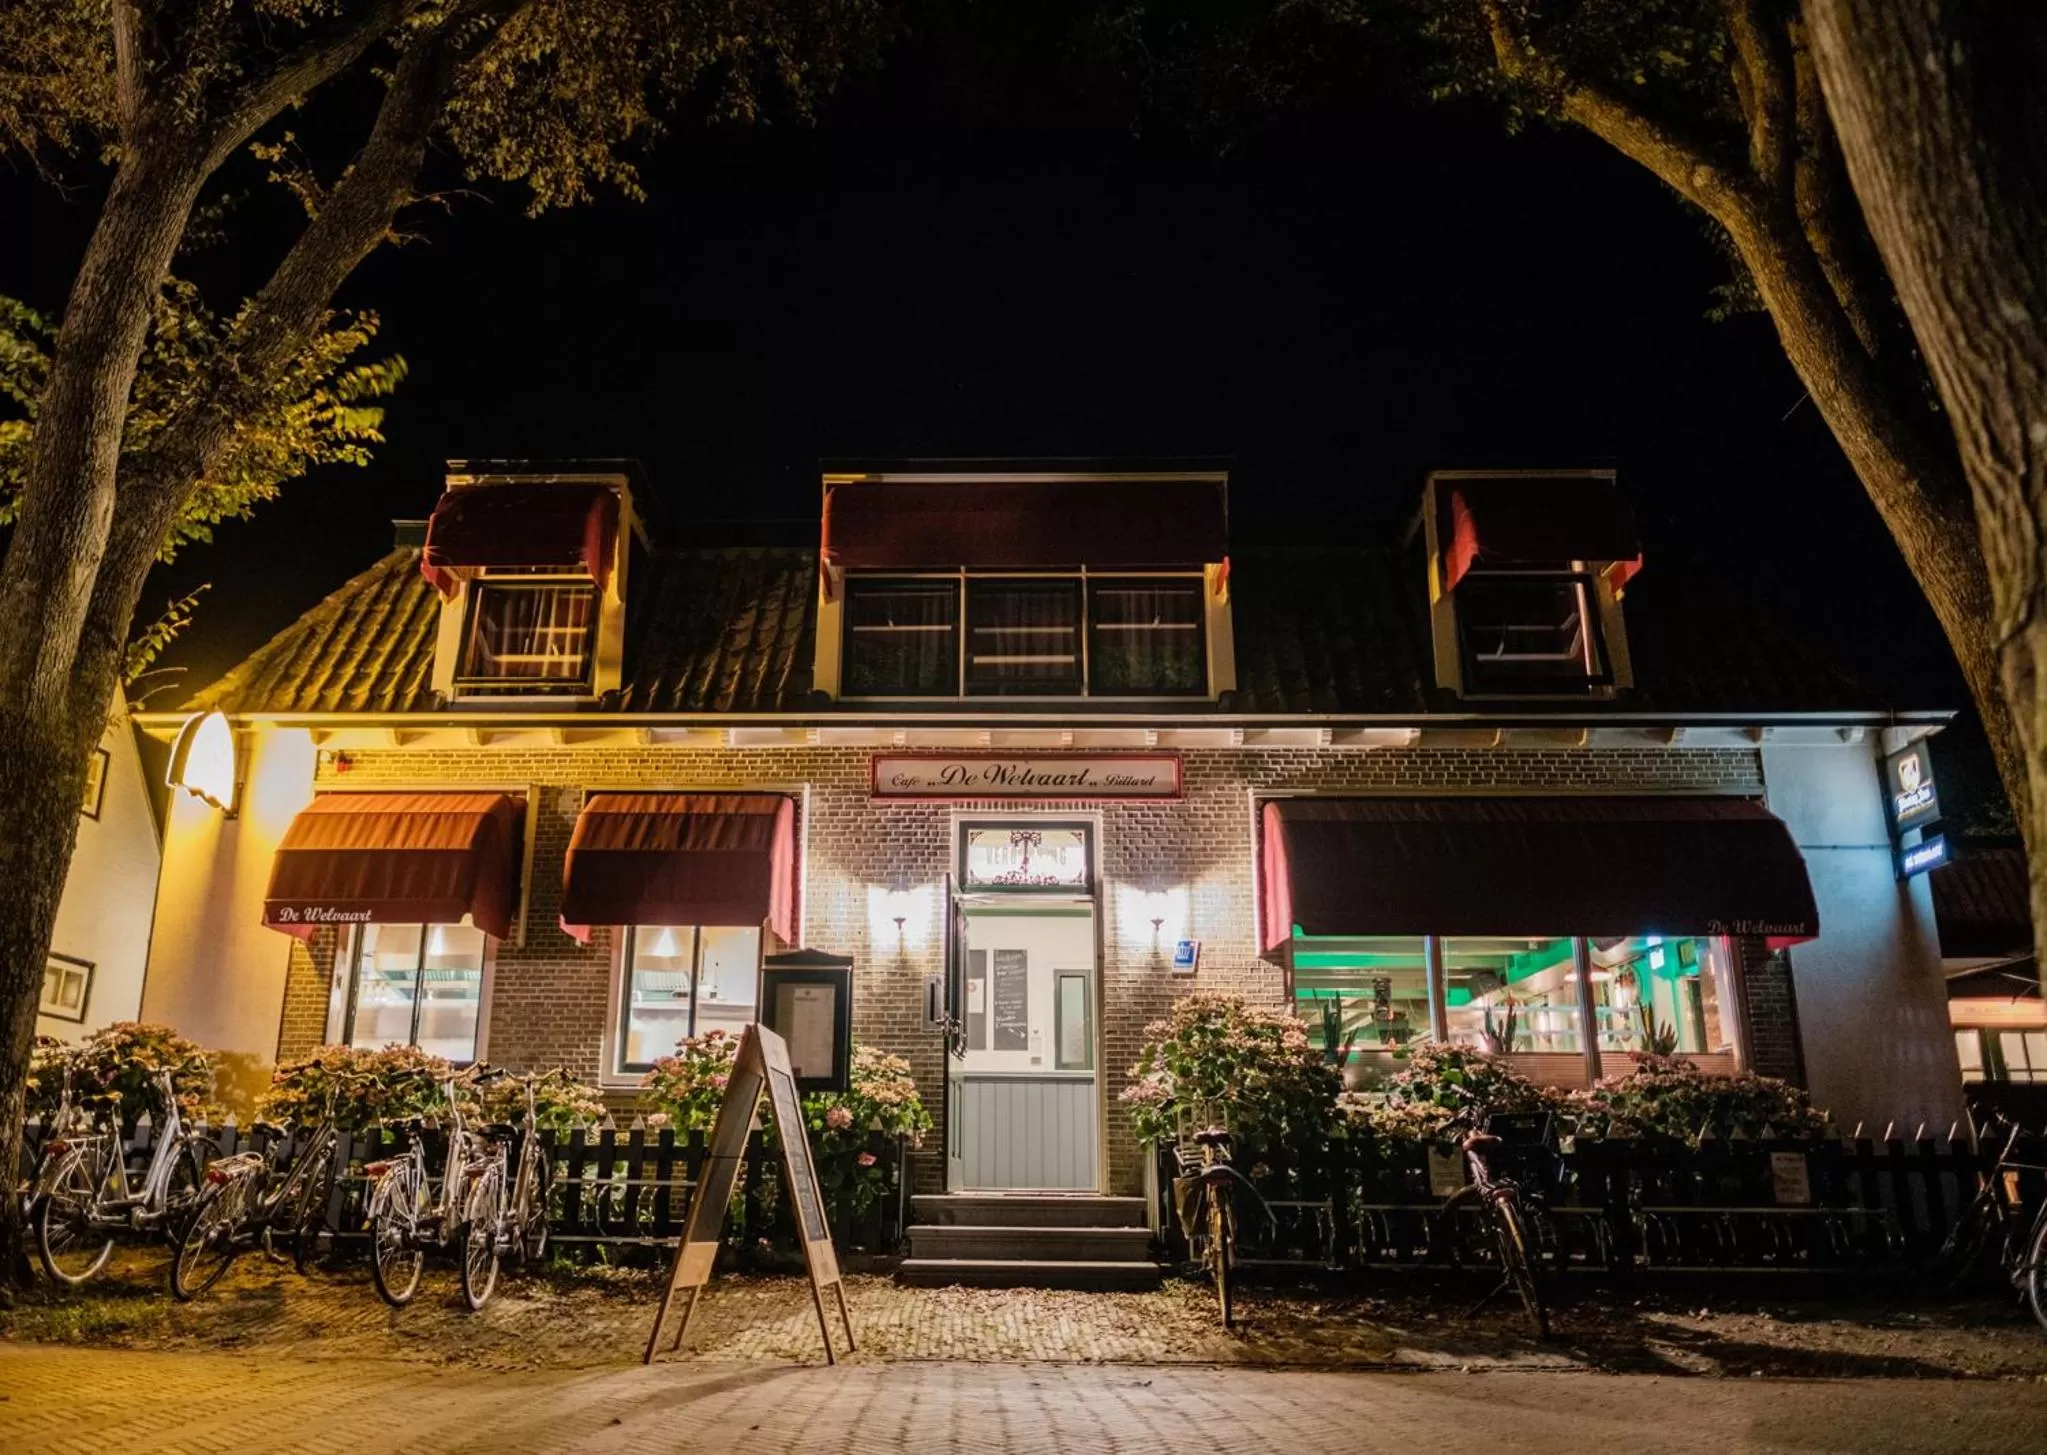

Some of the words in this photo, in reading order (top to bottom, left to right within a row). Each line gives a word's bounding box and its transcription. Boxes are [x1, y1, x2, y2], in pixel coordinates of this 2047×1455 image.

[279, 906, 300, 922] De
[303, 906, 372, 922] Welvaart
[1707, 919, 1729, 934] De
[1732, 919, 1805, 934] Welvaart
